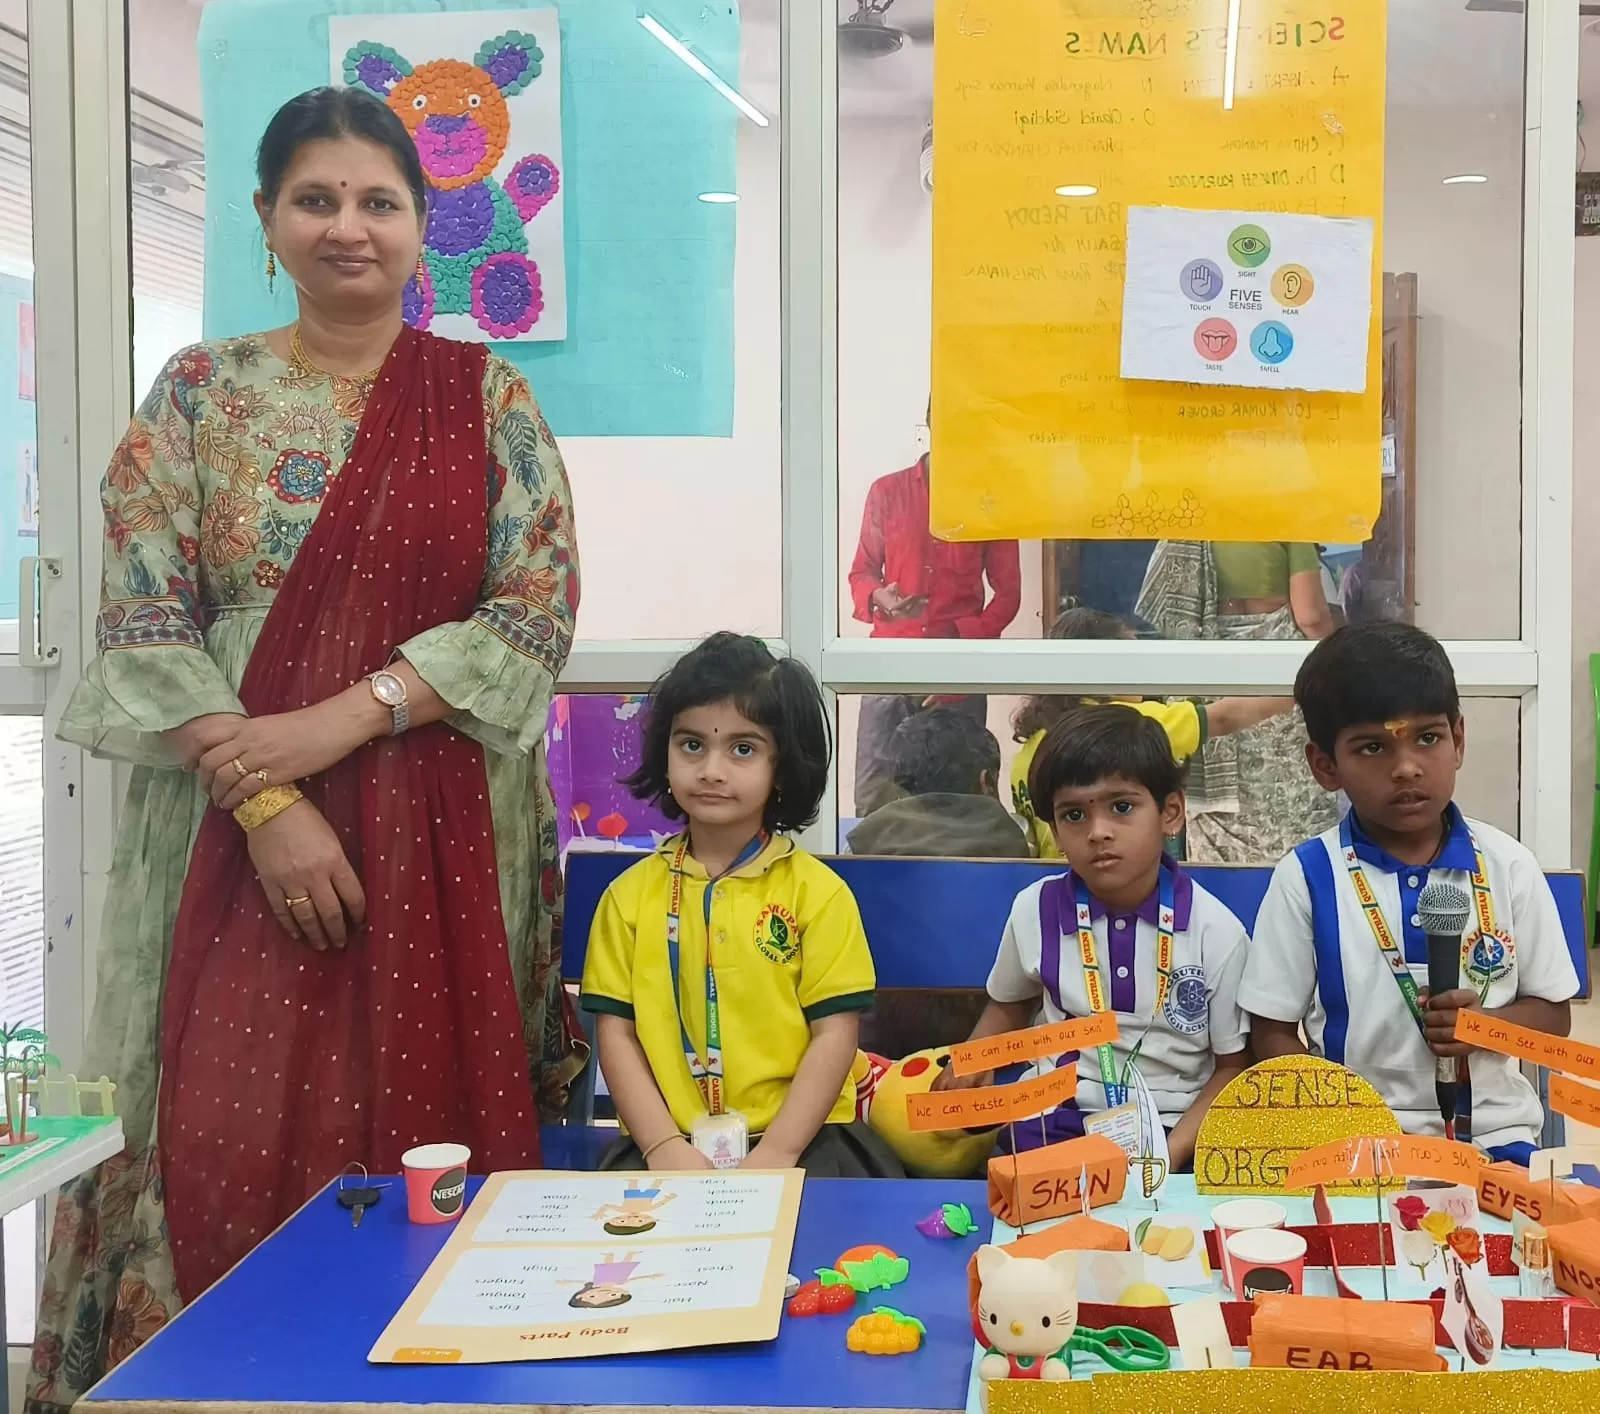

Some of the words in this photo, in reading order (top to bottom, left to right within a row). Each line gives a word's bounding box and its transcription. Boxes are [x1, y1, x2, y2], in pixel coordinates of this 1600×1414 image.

[1190, 304, 1211, 312] TOUCH
[1228, 301, 1263, 311] SENSES
[1230, 289, 1262, 302] FIVE
[1205, 364, 1224, 372] TASTE
[1353, 871, 1371, 903] QUEENS
[1479, 891, 1491, 932] GOUTHAM
[1370, 908, 1391, 948] GOUTHAM
[1082, 931, 1094, 963] QUEENS
[1160, 936, 1169, 968] QUEENS
[1088, 970, 1101, 1010] GOUTHAM
[981, 1046, 999, 1058] can
[1006, 1039, 1024, 1052] feel
[1033, 1034, 1052, 1046] with
[1059, 1030, 1075, 1040] our
[1544, 1045, 1568, 1059] with
[1576, 1054, 1595, 1066] our
[974, 1097, 1005, 1111] taste
[1012, 1092, 1030, 1104] with
[1108, 1085, 1118, 1108] OBAL
[1236, 1071, 1362, 1108] SENSE
[1030, 1167, 1111, 1209] SKIN
[1481, 1180, 1542, 1221] EYES
[519, 1331, 571, 1341] Parts
[579, 1326, 630, 1338] Body
[1286, 1347, 1373, 1370] EAR
